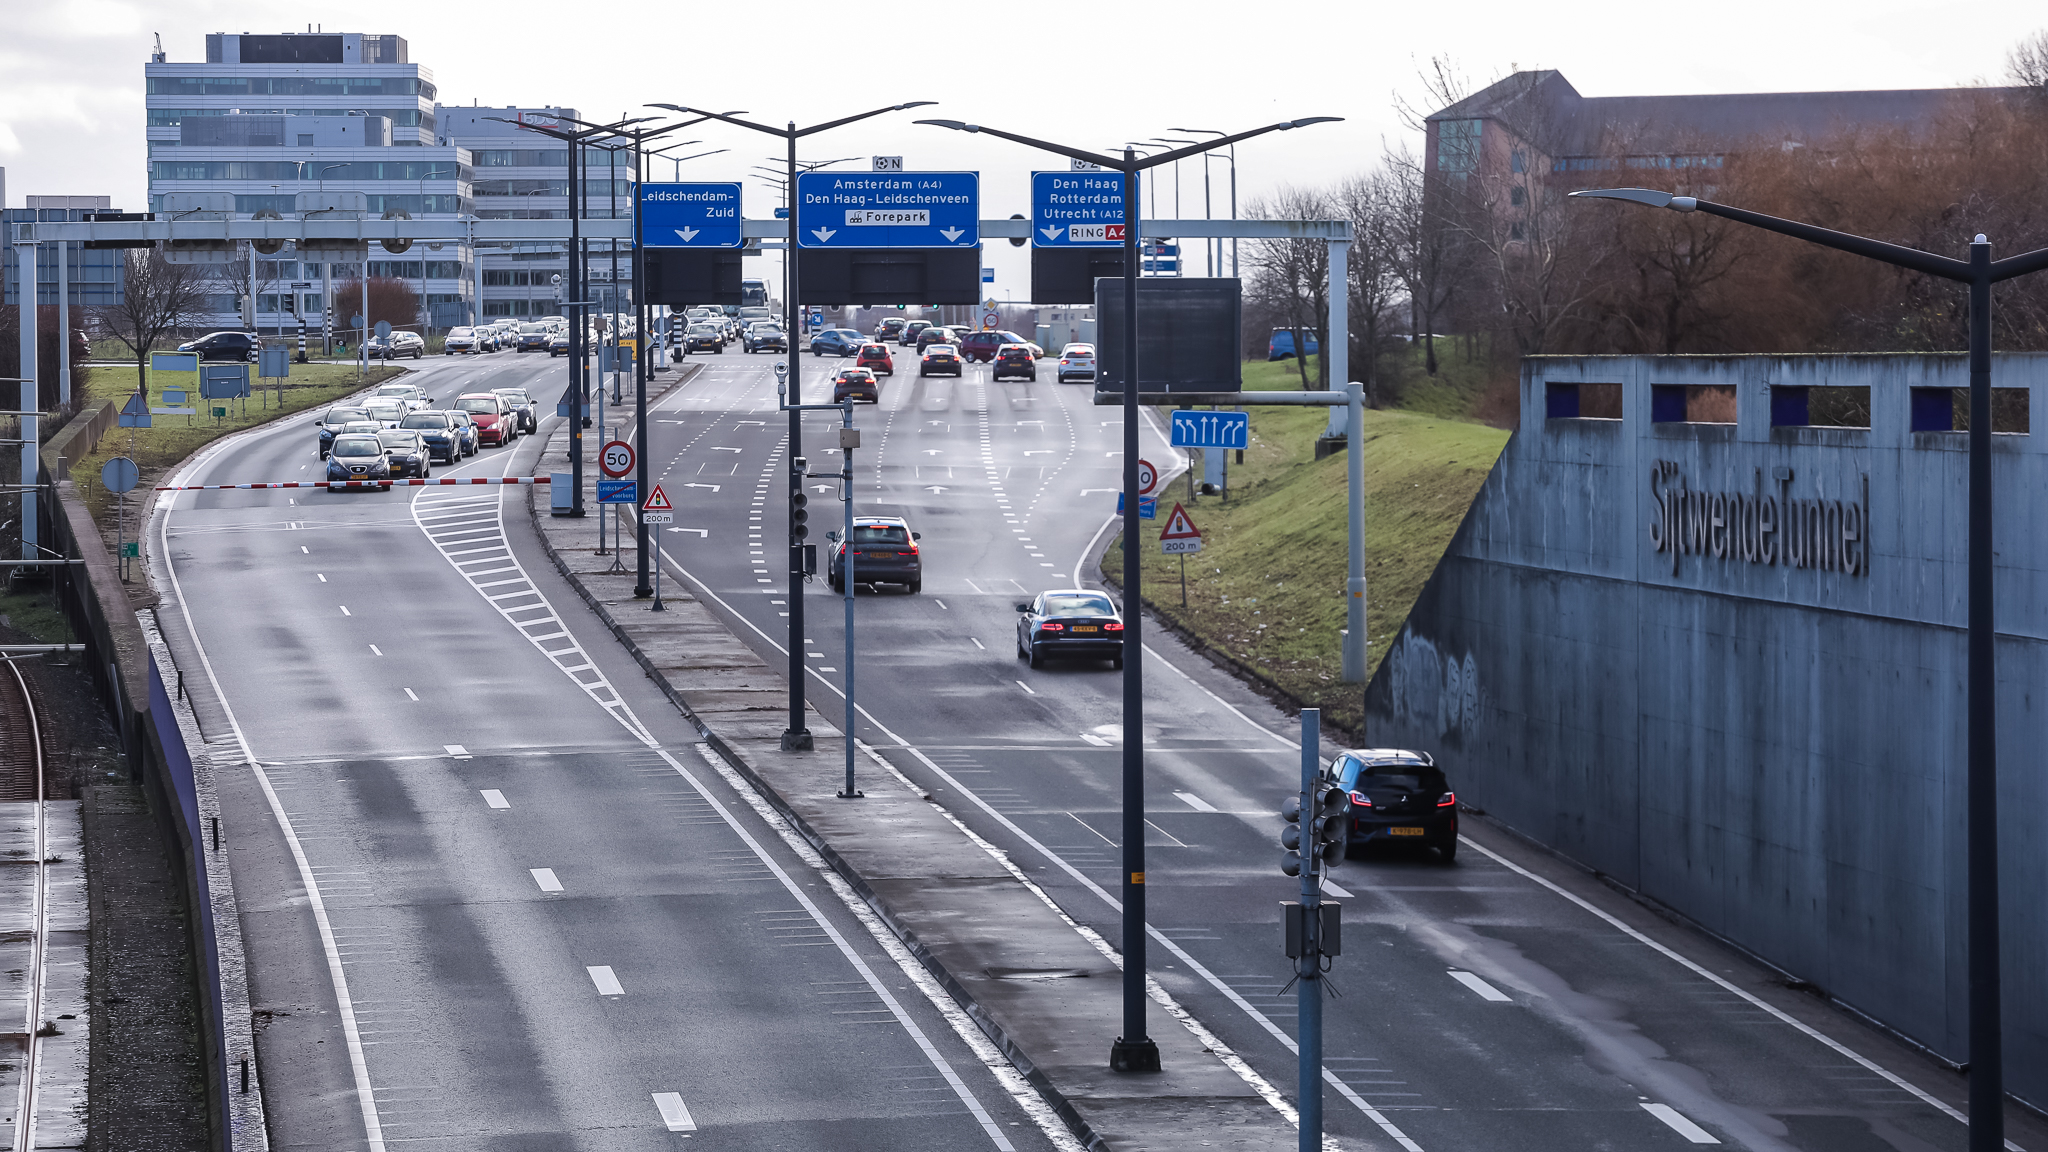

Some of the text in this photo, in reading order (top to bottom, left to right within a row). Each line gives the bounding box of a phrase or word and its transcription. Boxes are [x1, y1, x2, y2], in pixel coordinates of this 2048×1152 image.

[891, 159, 900, 169] N
[833, 179, 943, 190] Amsterdam (A4)
[1053, 179, 1118, 191] Den Haag
[806, 193, 830, 204] Den
[1050, 193, 1122, 204] Rotterdam
[706, 207, 734, 218] Zuid
[866, 212, 926, 223] Forepark
[1044, 209, 1124, 219] Utrecht (A12
[1071, 228, 1104, 238] RING
[606, 453, 628, 466] 50
[1165, 542, 1186, 551] 200
